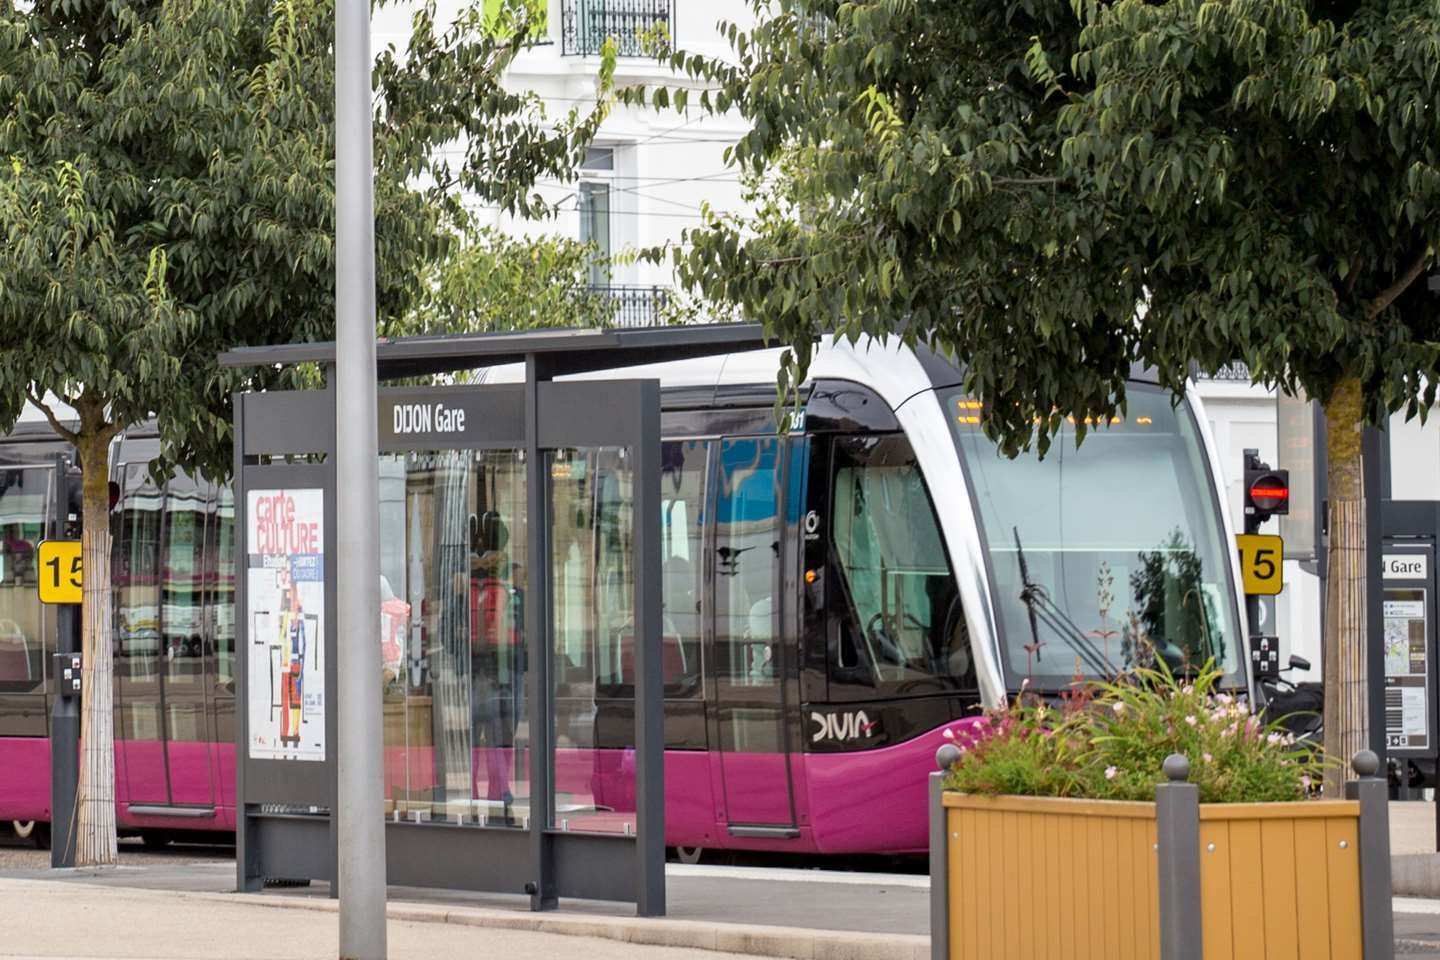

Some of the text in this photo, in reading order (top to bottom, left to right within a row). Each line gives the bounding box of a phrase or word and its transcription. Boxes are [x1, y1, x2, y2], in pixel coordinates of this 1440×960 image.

[393, 403, 465, 434] DIJON Gare
[256, 489, 295, 522] carte
[256, 522, 318, 554] CULTURE
[45, 556, 83, 588] 15
[1391, 559, 1422, 574] Gare
